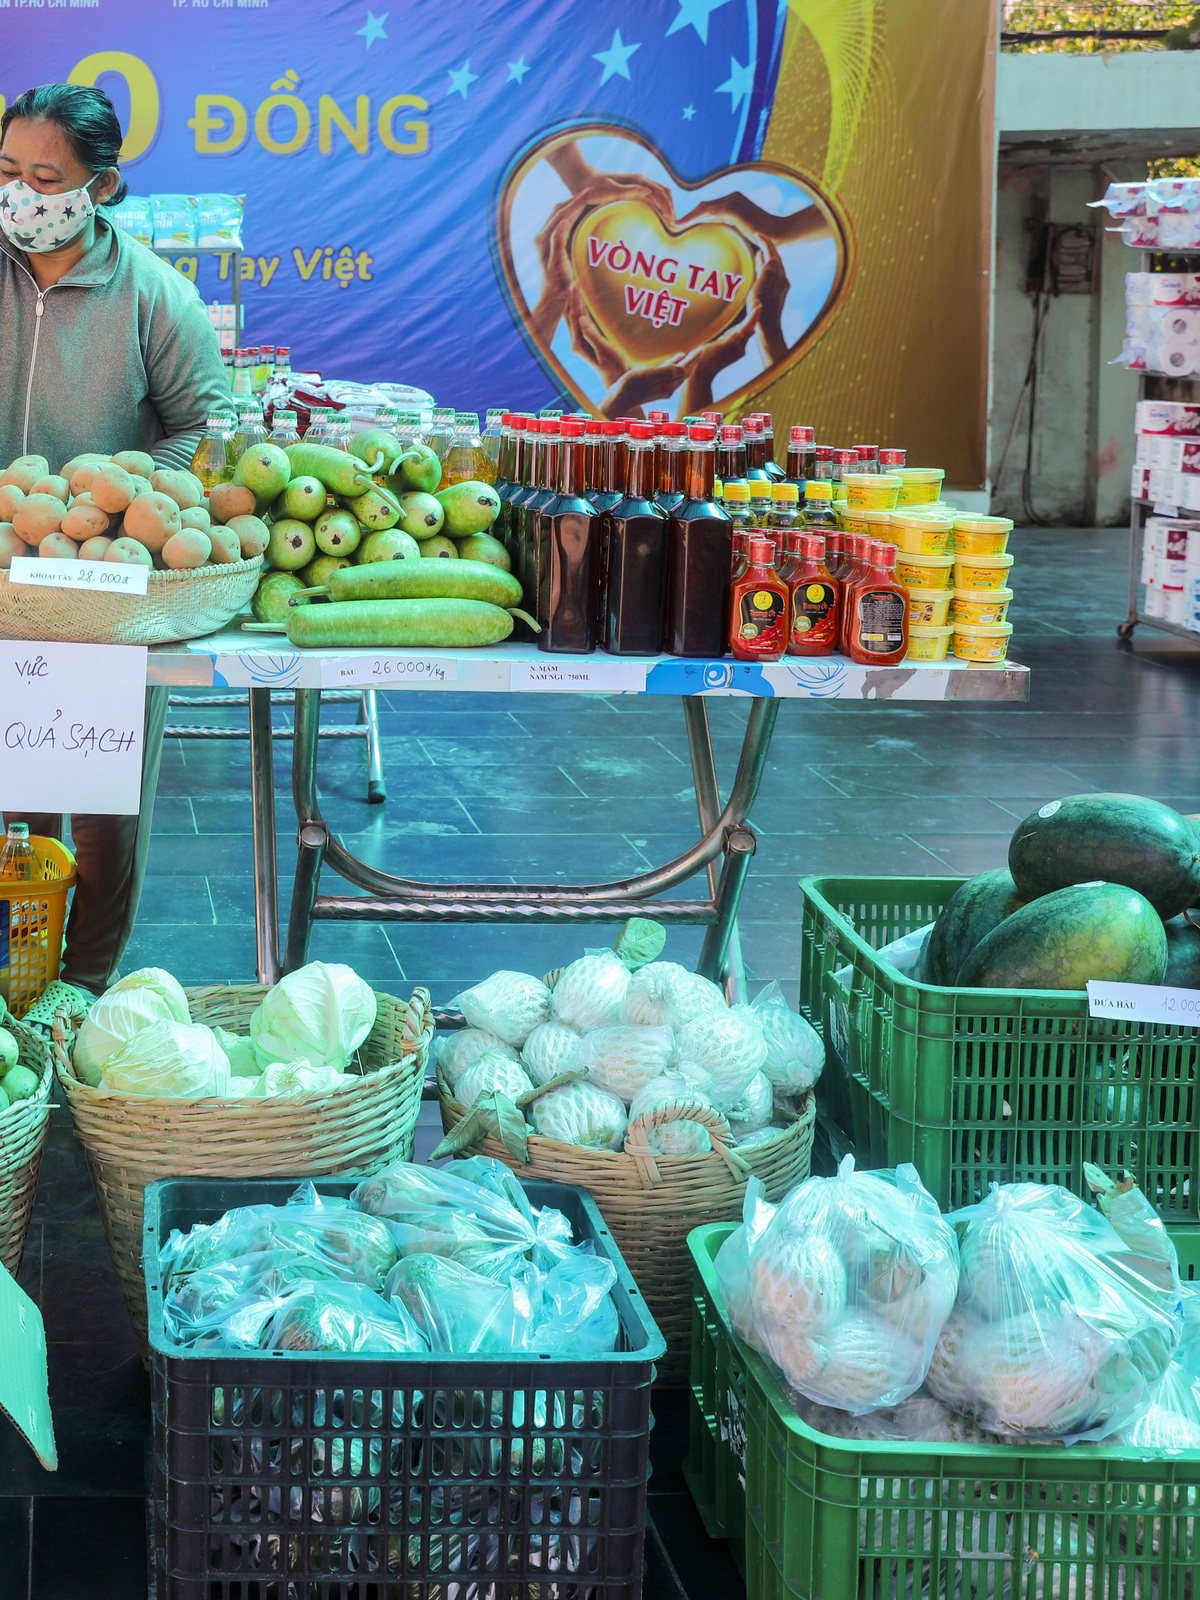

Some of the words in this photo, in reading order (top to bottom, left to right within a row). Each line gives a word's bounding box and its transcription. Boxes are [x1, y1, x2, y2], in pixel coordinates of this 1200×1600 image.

[187, 69, 430, 156] ĐỒNG
[213, 252, 281, 288] Tay
[292, 246, 375, 289] Việt
[587, 237, 680, 285] VÒNG
[687, 263, 744, 302] TAY
[624, 285, 690, 328] VIỆT
[30, 572, 55, 580] KHOAI
[14, 656, 50, 685] vực
[4, 709, 63, 750] QUẢ
[62, 723, 136, 758] SẠCH
[1094, 999, 1114, 1008] DƯA
